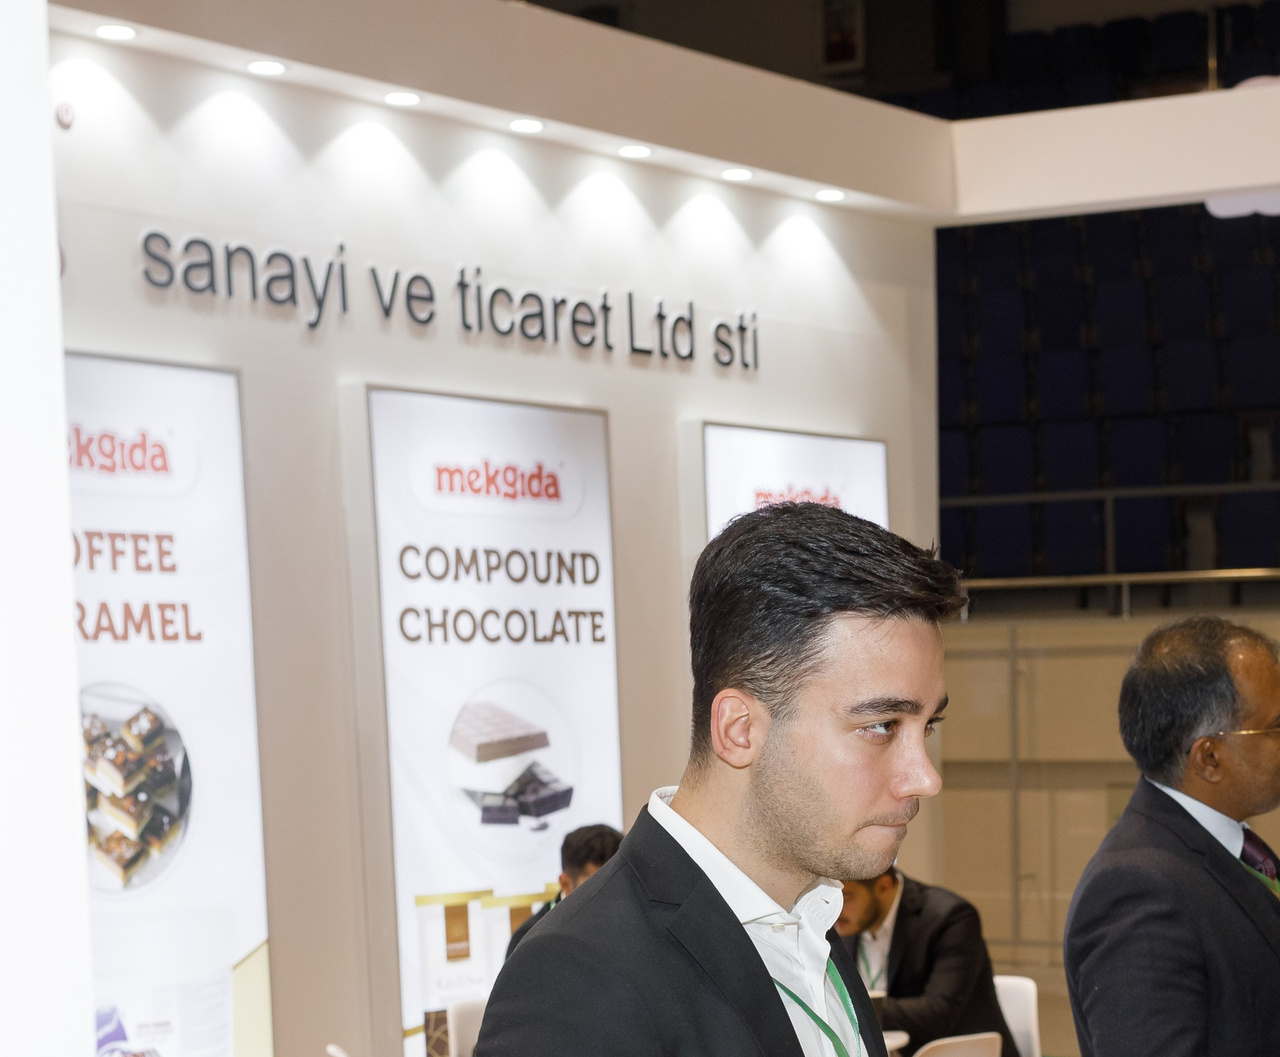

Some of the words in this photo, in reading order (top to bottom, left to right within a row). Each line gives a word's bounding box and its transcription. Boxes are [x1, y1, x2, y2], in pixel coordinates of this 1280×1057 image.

[143, 231, 349, 329] sanayi
[371, 265, 434, 325] ve
[456, 267, 614, 353] ticaret
[627, 291, 695, 362] Ltd
[713, 311, 758, 372] sti
[73, 531, 177, 572] FFEE
[399, 545, 600, 585] COMPOUND
[399, 607, 606, 643] CHOCOLATE
